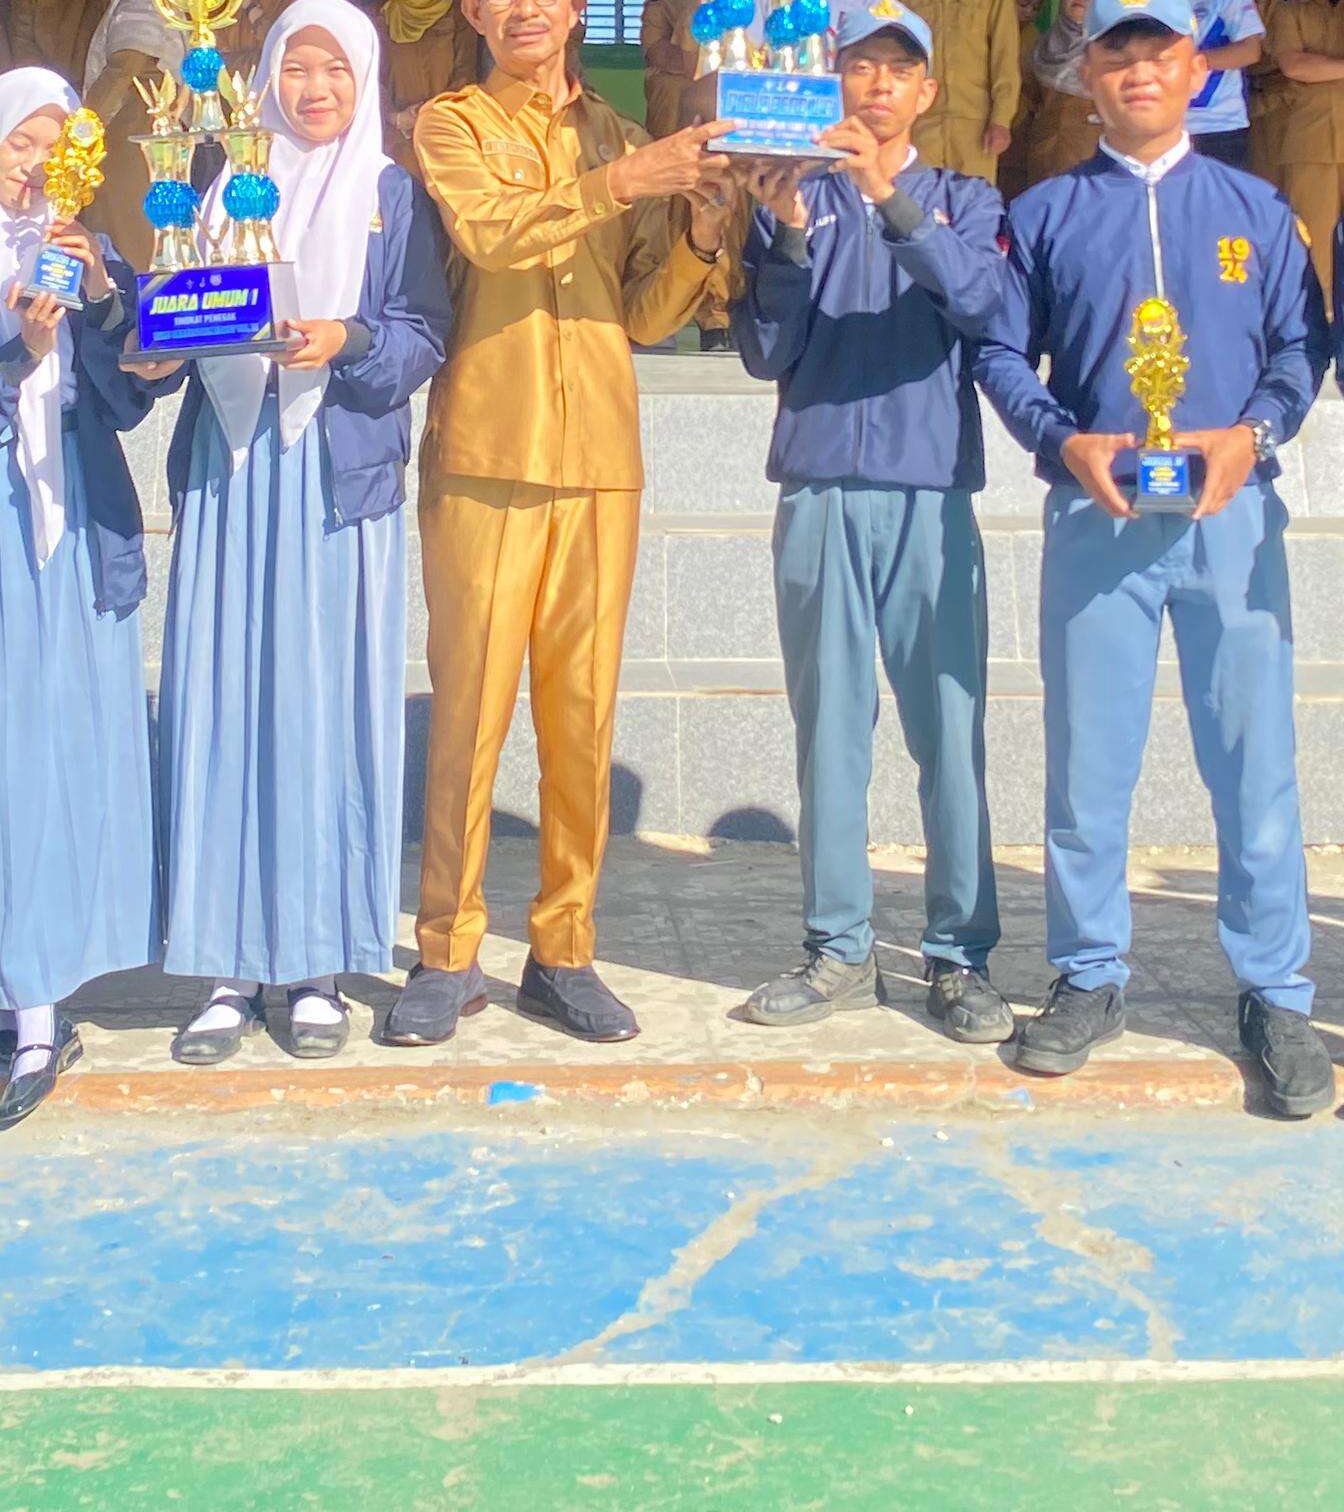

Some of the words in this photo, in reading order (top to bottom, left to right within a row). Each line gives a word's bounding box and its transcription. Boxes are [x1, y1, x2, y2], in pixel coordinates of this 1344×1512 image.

[1217, 236, 1251, 261] 19
[1219, 260, 1249, 284] 24
[149, 292, 199, 315] JUARA
[201, 288, 249, 310] UMUM
[174, 315, 204, 326] TINGKAT
[205, 312, 237, 324] PENEGAK
